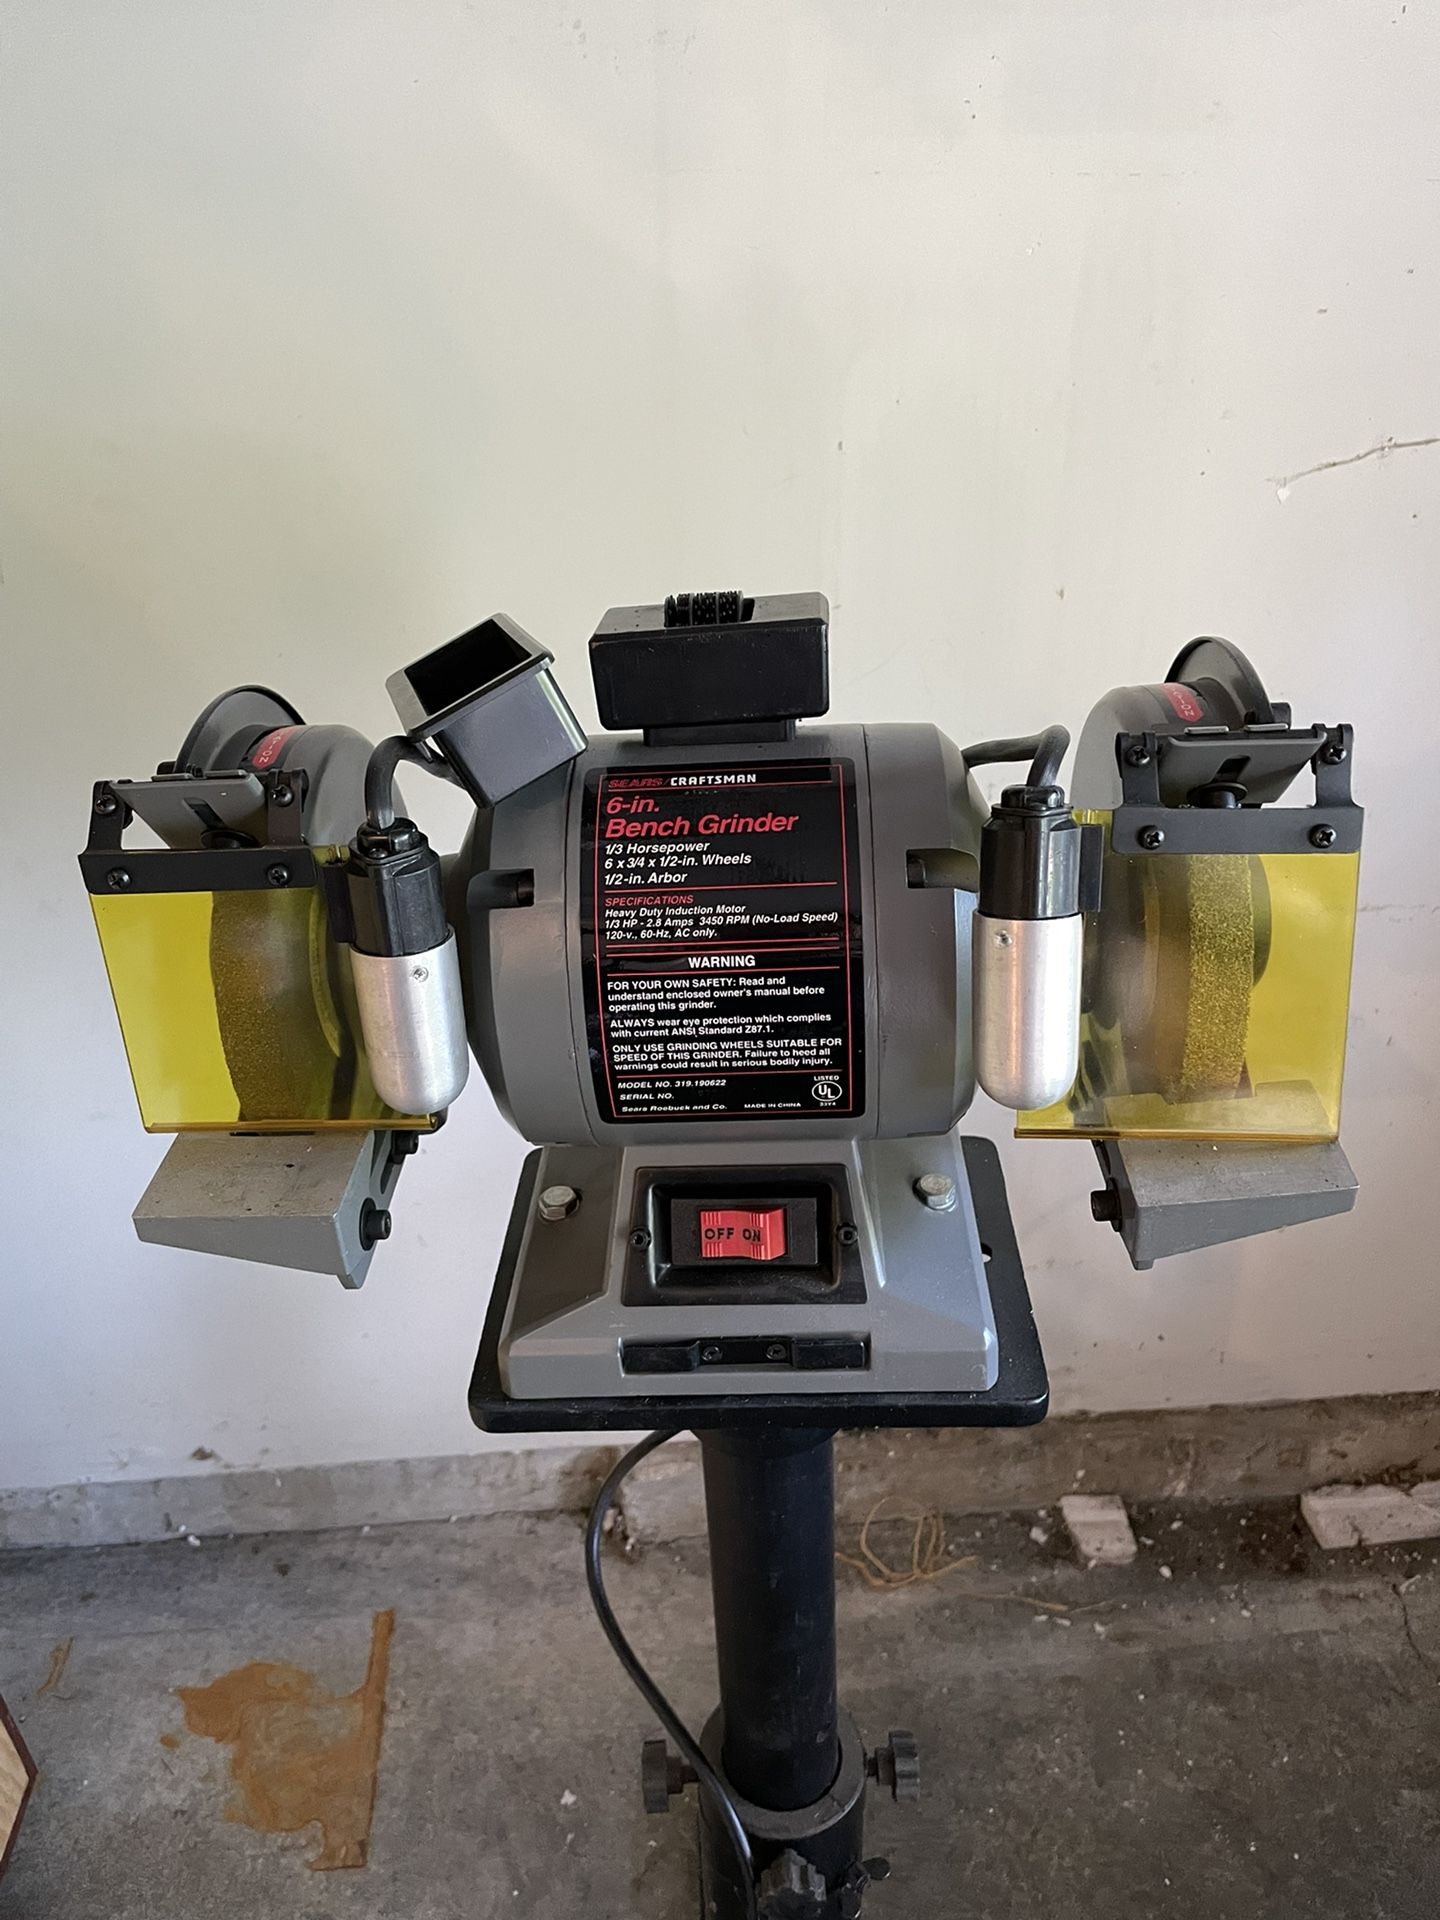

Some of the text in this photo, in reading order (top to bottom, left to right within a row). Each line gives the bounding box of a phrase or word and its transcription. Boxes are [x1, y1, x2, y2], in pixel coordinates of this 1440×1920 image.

[671, 774, 756, 786] CRAFTSMAN
[607, 796, 659, 814] 6-in.
[606, 813, 799, 838] Bench Grinder
[606, 842, 710, 855] 1/3 Horsepower
[605, 853, 751, 869] 6 x 3/4 x 1/2-in. Wheels
[605, 872, 688, 885] 1/2-in. Arbor
[605, 895, 694, 906] SPECIFICATIONS
[605, 905, 746, 919] Heavy Duty Induction Motor
[606, 920, 620, 928] 1/3
[623, 919, 638, 928] HP
[646, 918, 662, 927] 2.8
[664, 918, 693, 928] Amps
[700, 916, 724, 926] 3450
[726, 915, 750, 924] RPM
[752, 914, 800, 926] (No-Load
[802, 912, 838, 924] Speed)
[641, 930, 671, 938] 60-Hz,
[675, 928, 690, 937] AC
[693, 928, 717, 938] only.
[688, 955, 755, 968] WARNING
[608, 976, 785, 990] FOR YOUR OWN SAFETY: Read and
[608, 986, 824, 1001] understand enclosed owner's manual before
[609, 1000, 716, 1013] operating this grinder.
[610, 1018, 654, 1028] ALWAYS
[683, 1019, 700, 1027] eye
[703, 1016, 752, 1026] protection
[755, 1015, 784, 1023] which
[787, 1014, 831, 1023] complies
[611, 1025, 774, 1038] with current ANSI Standard Z87.1.
[644, 1044, 664, 1052] USE
[667, 1042, 718, 1051] GRINDING
[720, 1040, 764, 1049] WHEELS
[767, 1039, 817, 1048] SUITABLE
[820, 1038, 842, 1046] FOR
[614, 1054, 648, 1062] SPEED
[667, 1052, 690, 1060] THIS
[693, 1051, 742, 1059] GRINDER.
[793, 1048, 816, 1056] heed
[615, 1063, 658, 1071] warnings
[691, 1060, 718, 1068] result
[770, 1058, 800, 1066] bodily
[802, 1058, 832, 1066] injury.
[818, 1084, 836, 1099] UL
[705, 1228, 761, 1242] OFF ON
